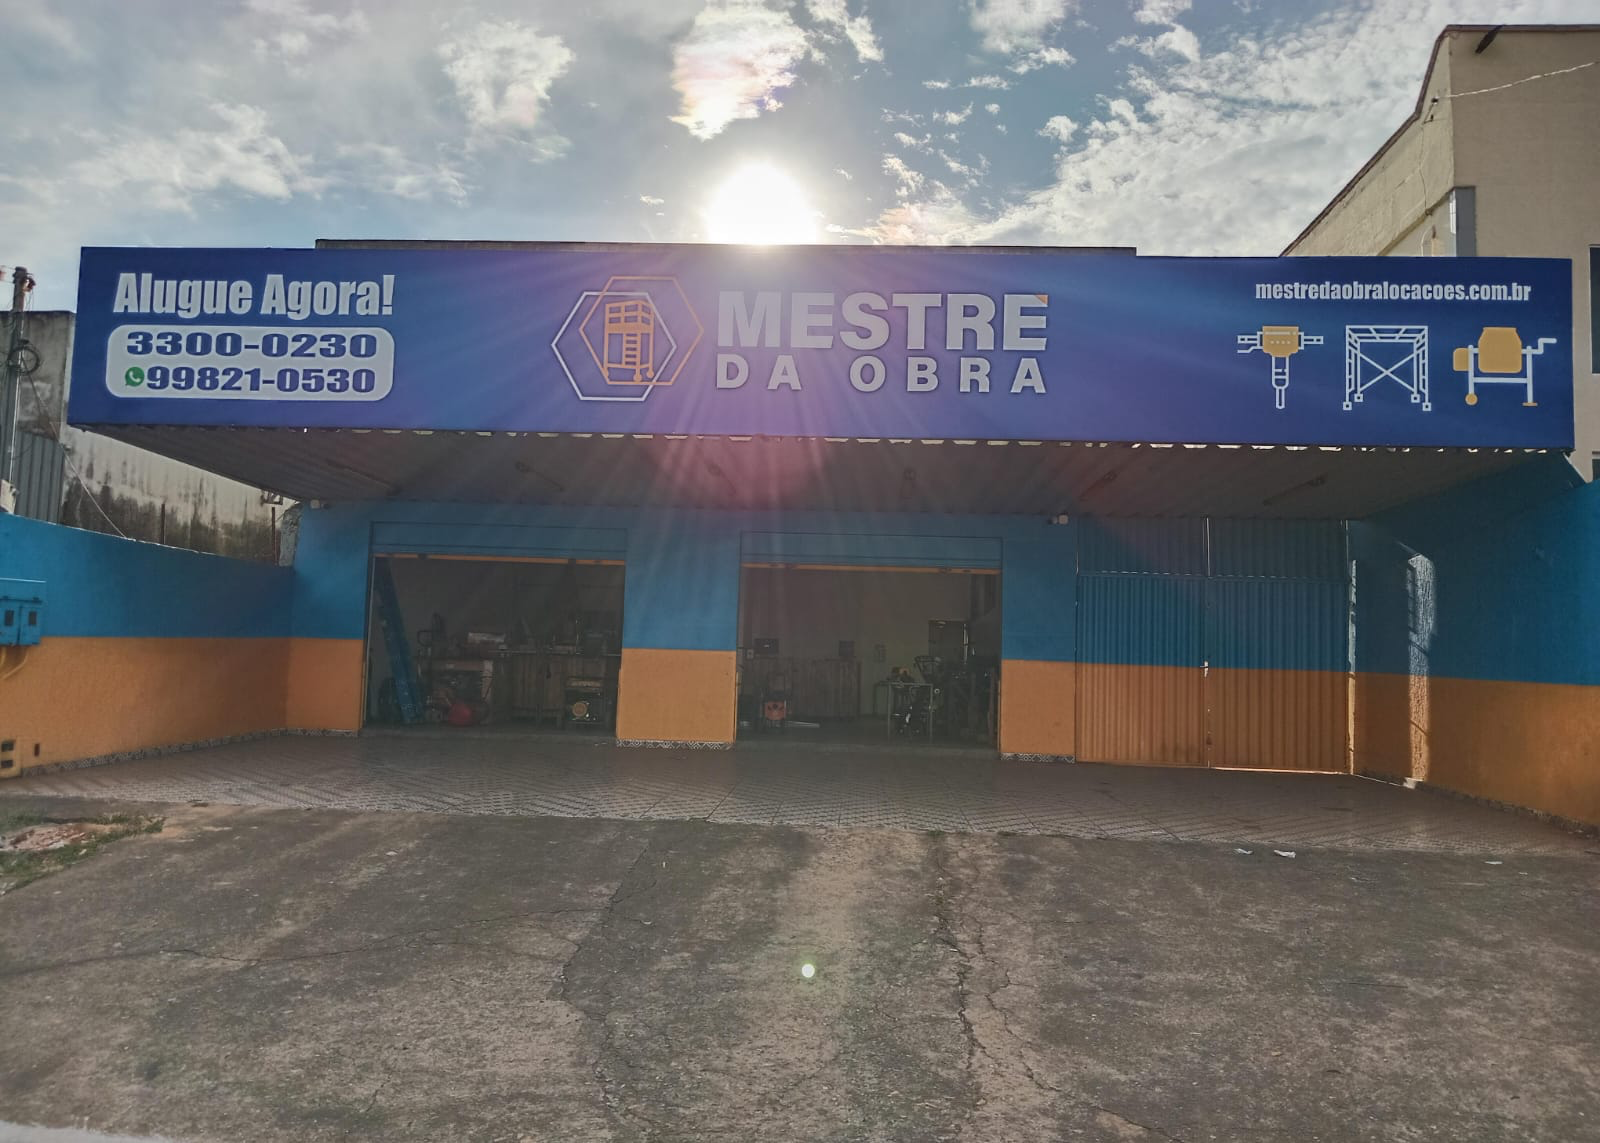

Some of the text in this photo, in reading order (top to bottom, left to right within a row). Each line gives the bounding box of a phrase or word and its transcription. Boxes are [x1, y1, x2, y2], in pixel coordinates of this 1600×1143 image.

[113, 272, 396, 320] Alugue Agora!
[1255, 281, 1532, 302] mestredaobralocacoes.com.br
[717, 290, 1049, 351] MESTRE
[126, 331, 377, 358] 3300-0230
[146, 366, 376, 393] 99821-0530
[716, 353, 1047, 394] DA OBRA
